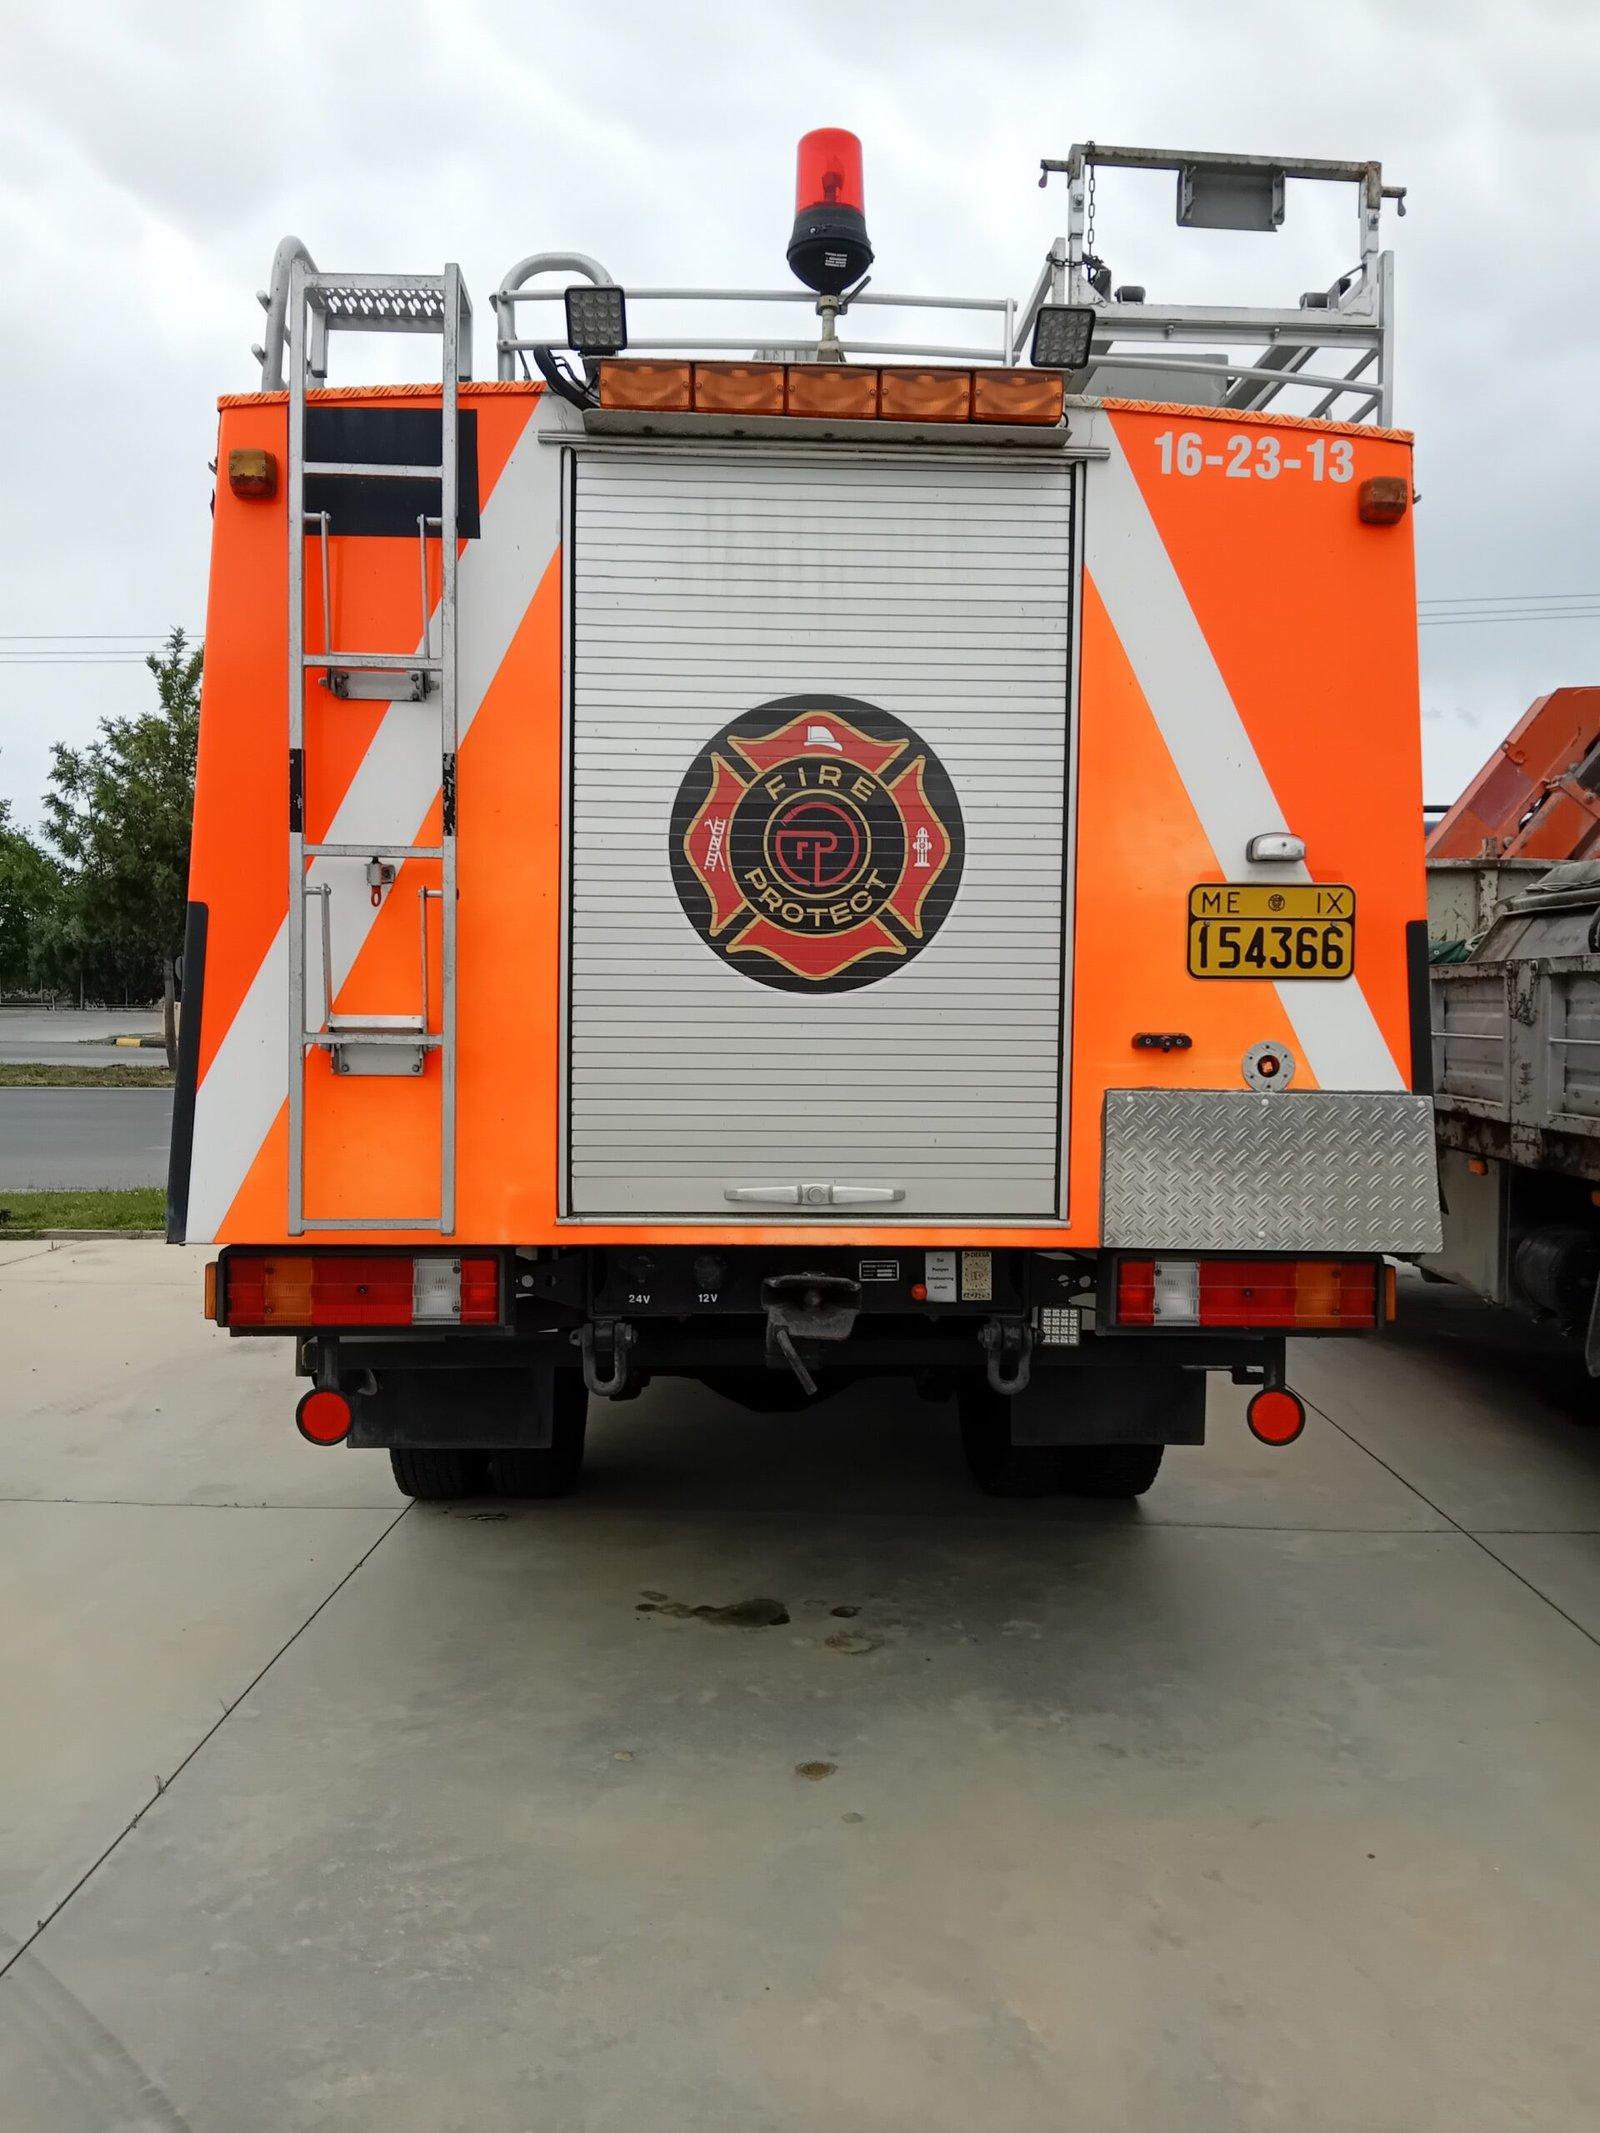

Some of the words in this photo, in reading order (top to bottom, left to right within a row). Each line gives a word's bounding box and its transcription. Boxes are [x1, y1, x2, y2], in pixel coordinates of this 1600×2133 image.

[1153, 431, 1355, 483] 16-23-13
[764, 765, 876, 802] FIRE
[744, 867, 886, 927] PROTECT
[1202, 891, 1240, 913] ME
[1317, 892, 1344, 914] IX
[1198, 926, 1344, 969] 154366
[628, 1294, 651, 1304] 24V
[698, 1293, 718, 1303] 12V
